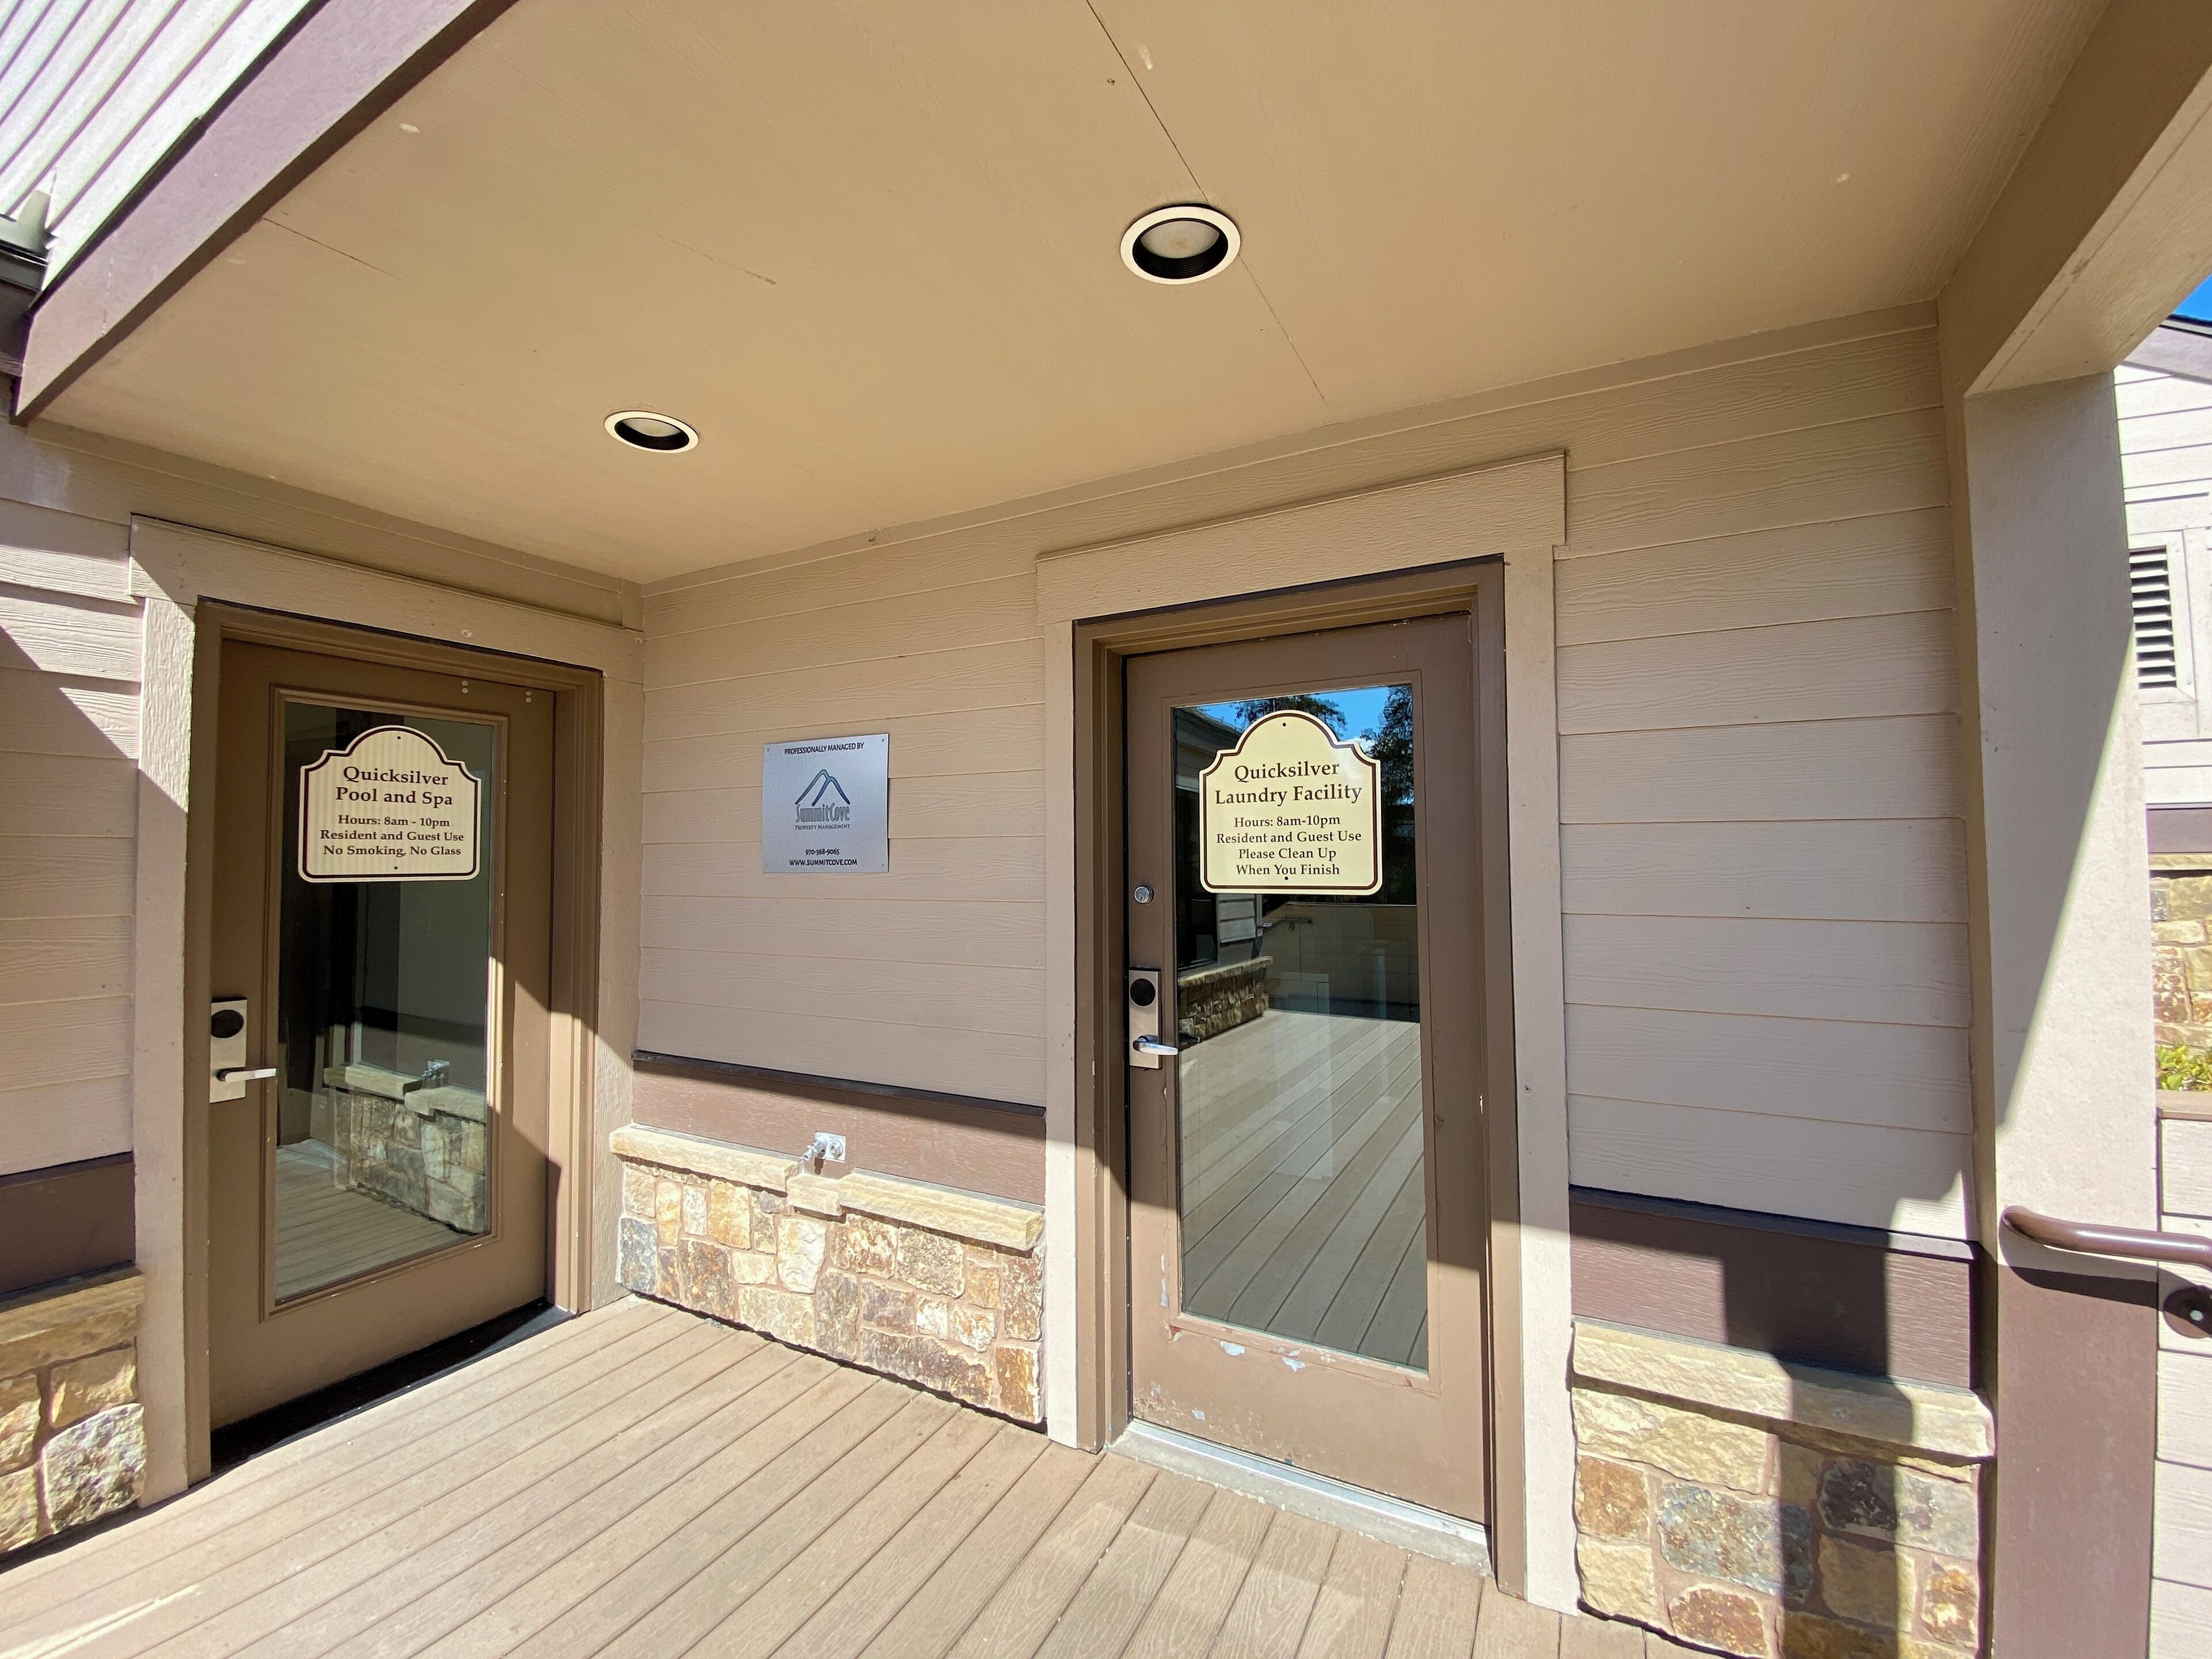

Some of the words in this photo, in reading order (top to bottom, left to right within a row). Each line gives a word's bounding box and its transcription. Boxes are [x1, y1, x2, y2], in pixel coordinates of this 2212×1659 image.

[785, 745, 828, 755] PROFESSIONALLY
[828, 743, 855, 751] MANAGED
[343, 767, 448, 785] Quicksilver
[1234, 761, 1339, 782] Quicksilver
[336, 787, 377, 801] Pool
[384, 791, 416, 803] and
[422, 791, 453, 808] Spa
[1215, 787, 1287, 806] Laundry
[1293, 783, 1362, 804] Facility
[338, 815, 381, 825] Hours:
[384, 817, 408, 825] 8am
[420, 818, 450, 829] 10pm
[1234, 817, 1273, 827] Hours:
[1277, 815, 1340, 828] 8am-10pm
[320, 830, 377, 839] Resident
[381, 831, 403, 840] and
[407, 832, 440, 840] Guest
[444, 832, 464, 841] Use
[1217, 832, 1267, 843] Resident
[1271, 832, 1292, 842] and
[1297, 831, 1334, 842] Guest
[1338, 831, 1361, 841] Use
[323, 846, 343, 854] No
[347, 846, 406, 857] Smoking,
[410, 846, 427, 855] No
[431, 847, 461, 855] Glass
[1238, 849, 1275, 858] Please
[1279, 849, 1313, 858] Clean
[1318, 848, 1336, 861] Up
[1236, 865, 1270, 874] When
[1274, 864, 1296, 874] You
[1301, 864, 1339, 874] Finish
